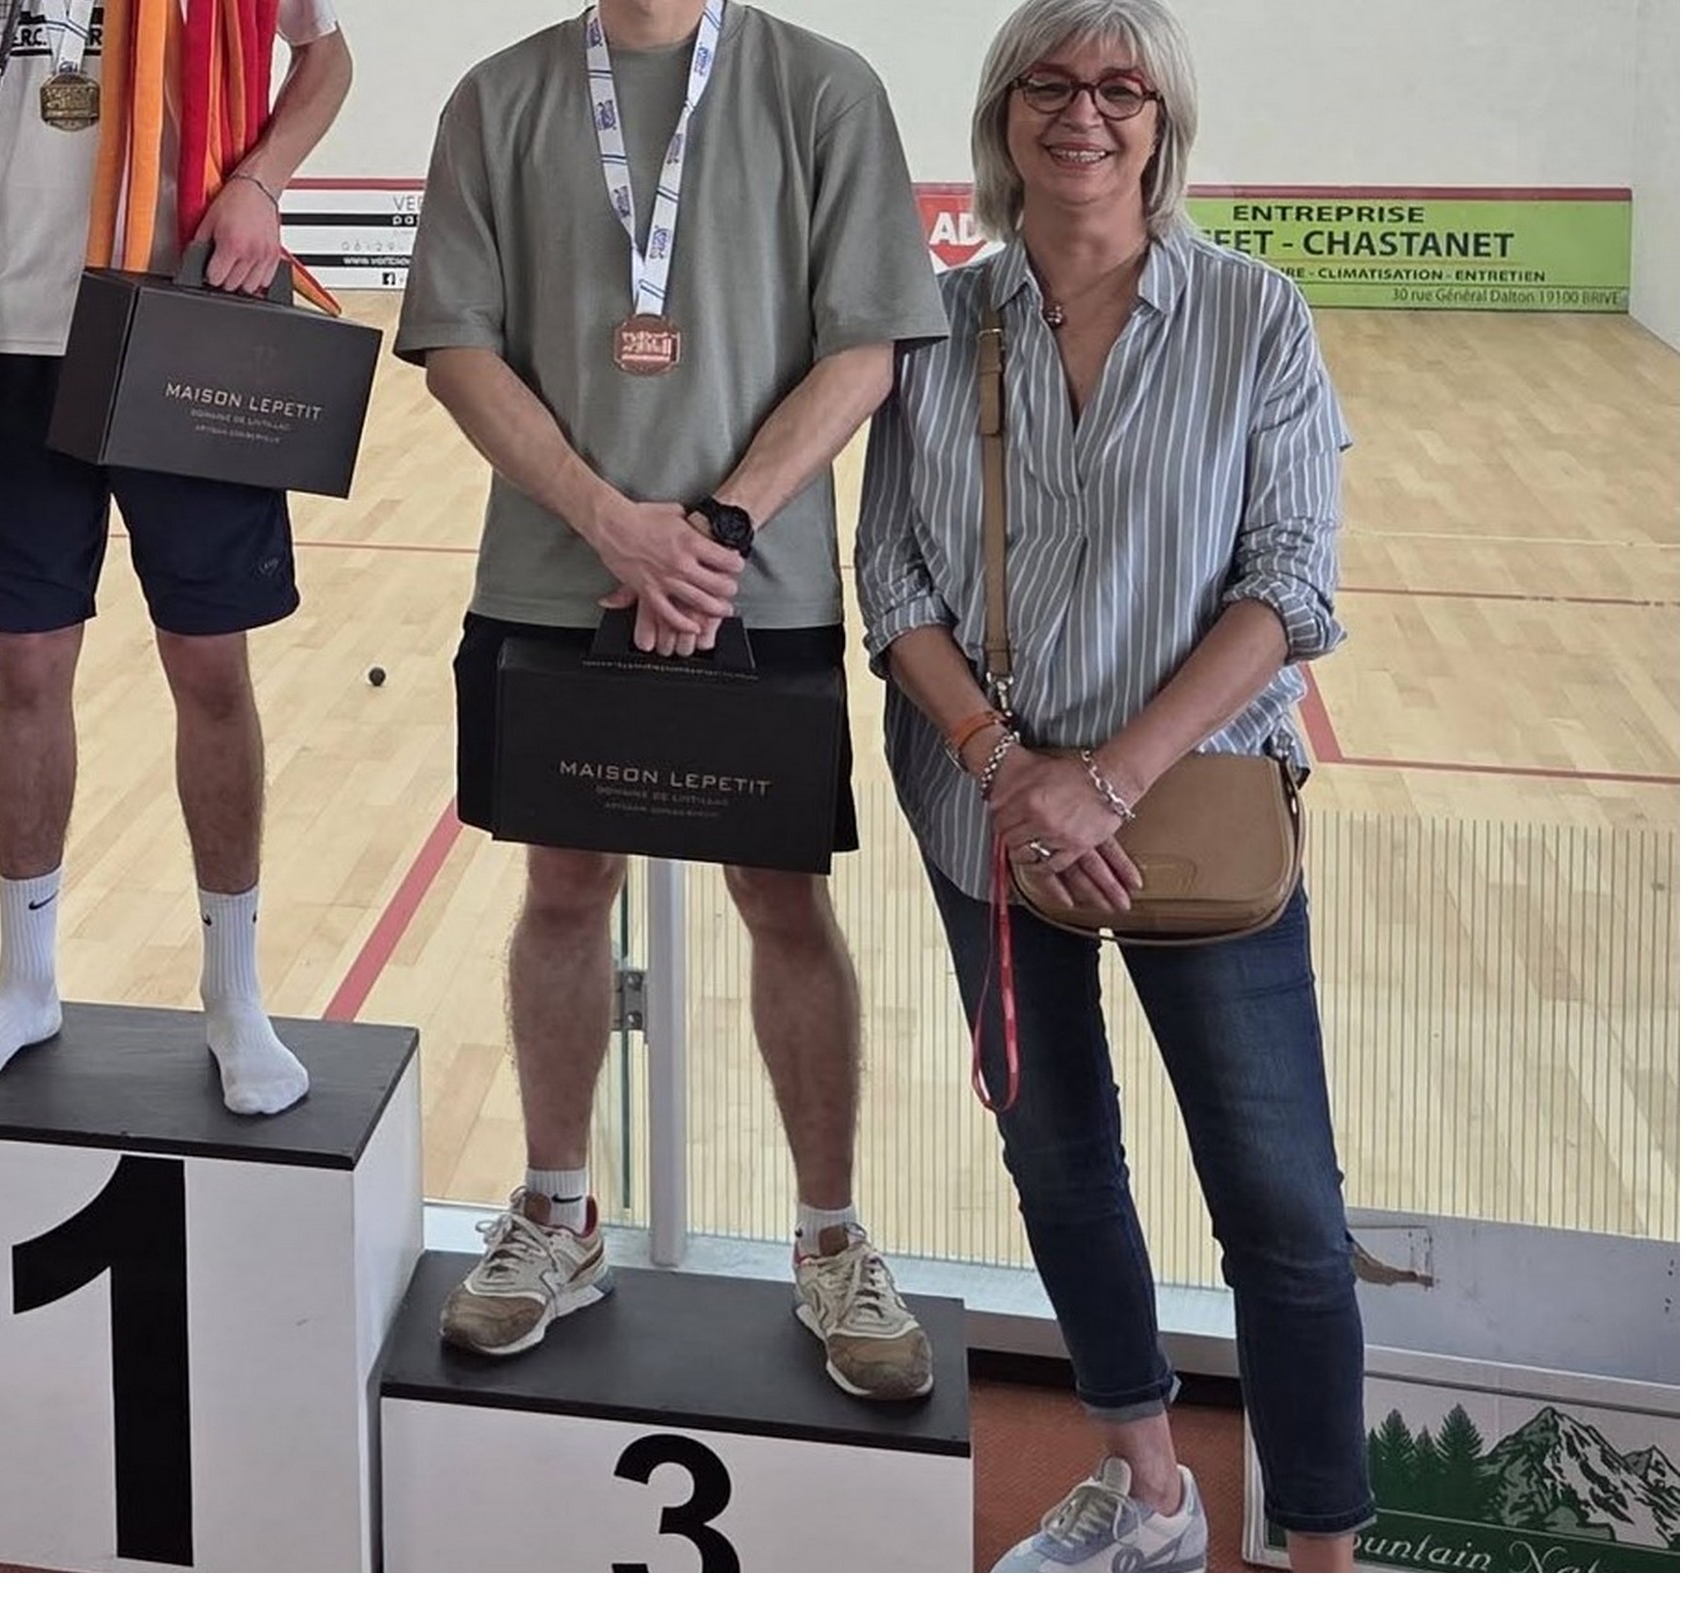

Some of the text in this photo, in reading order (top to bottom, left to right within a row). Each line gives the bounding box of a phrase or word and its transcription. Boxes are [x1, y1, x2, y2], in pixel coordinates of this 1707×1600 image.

[929, 211, 984, 247] AD
[1233, 205, 1425, 223] ENTREPRISE
[1303, 229, 1515, 258] CHASTANET
[1318, 267, 1546, 283] CLIMATISATION ENTRETIEN
[1392, 290, 1408, 301] 30
[1410, 291, 1432, 302] rue
[1435, 288, 1487, 302] Général
[1538, 290, 1579, 304] 19100
[1581, 291, 1618, 305] BRIVE
[165, 381, 323, 421] MAISON LEPETIT
[559, 759, 773, 796] MAISON LEPETIT
[11, 1152, 194, 1569] 1
[611, 1432, 740, 1574] 3
